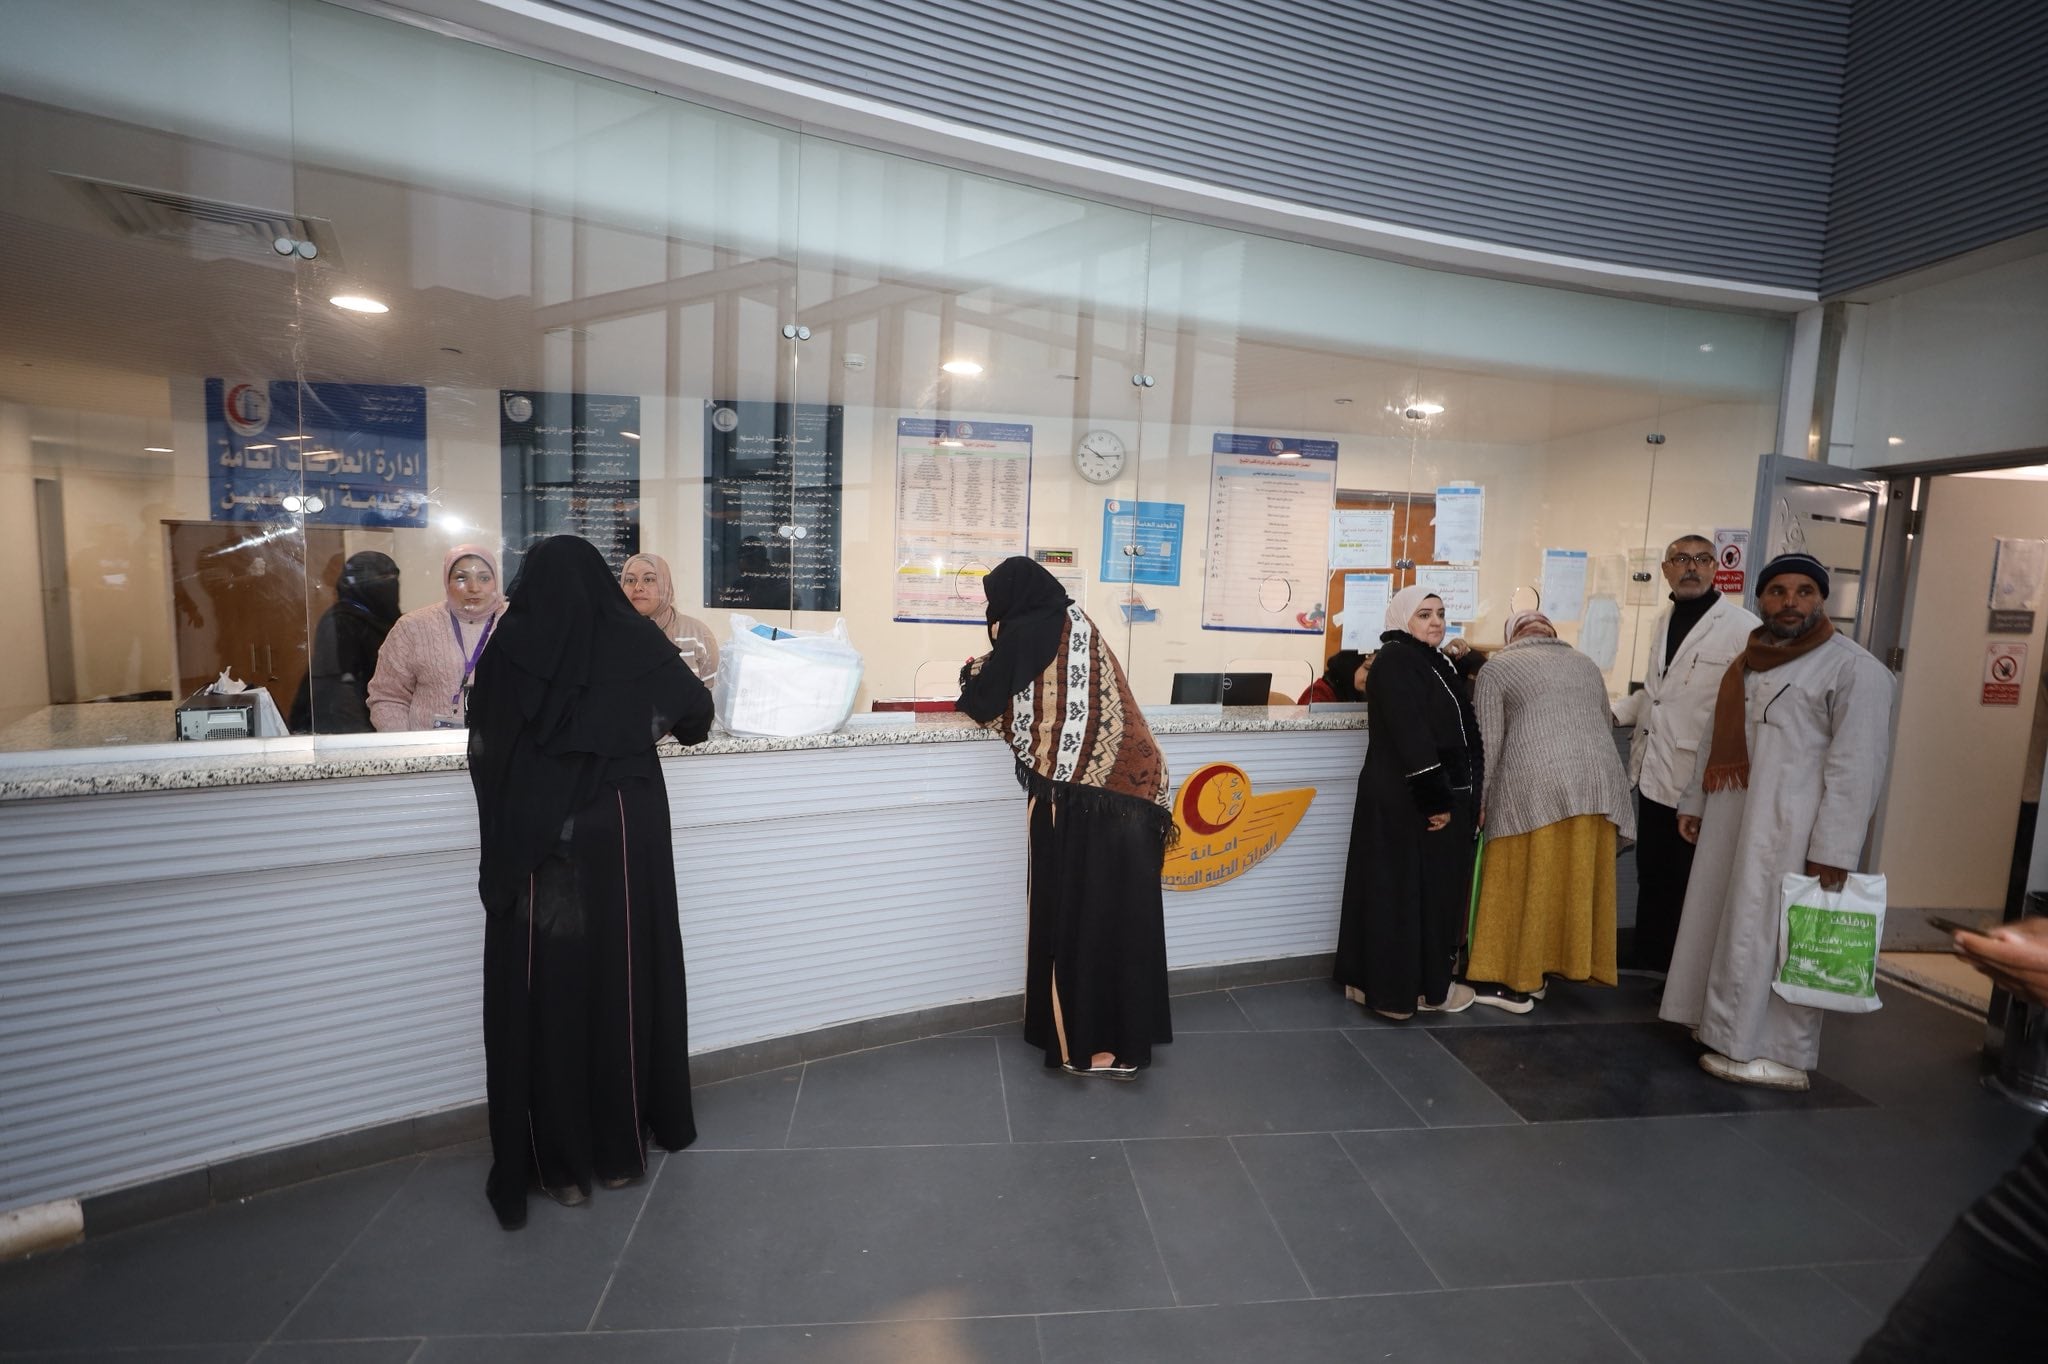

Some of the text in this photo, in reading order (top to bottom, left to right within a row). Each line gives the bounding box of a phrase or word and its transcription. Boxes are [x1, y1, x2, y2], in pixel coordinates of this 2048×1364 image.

[217, 438, 420, 484] إدارة العلاقات العامة
[1205, 858, 1238, 883] الطبية
[1242, 831, 1278, 871] المراكز
